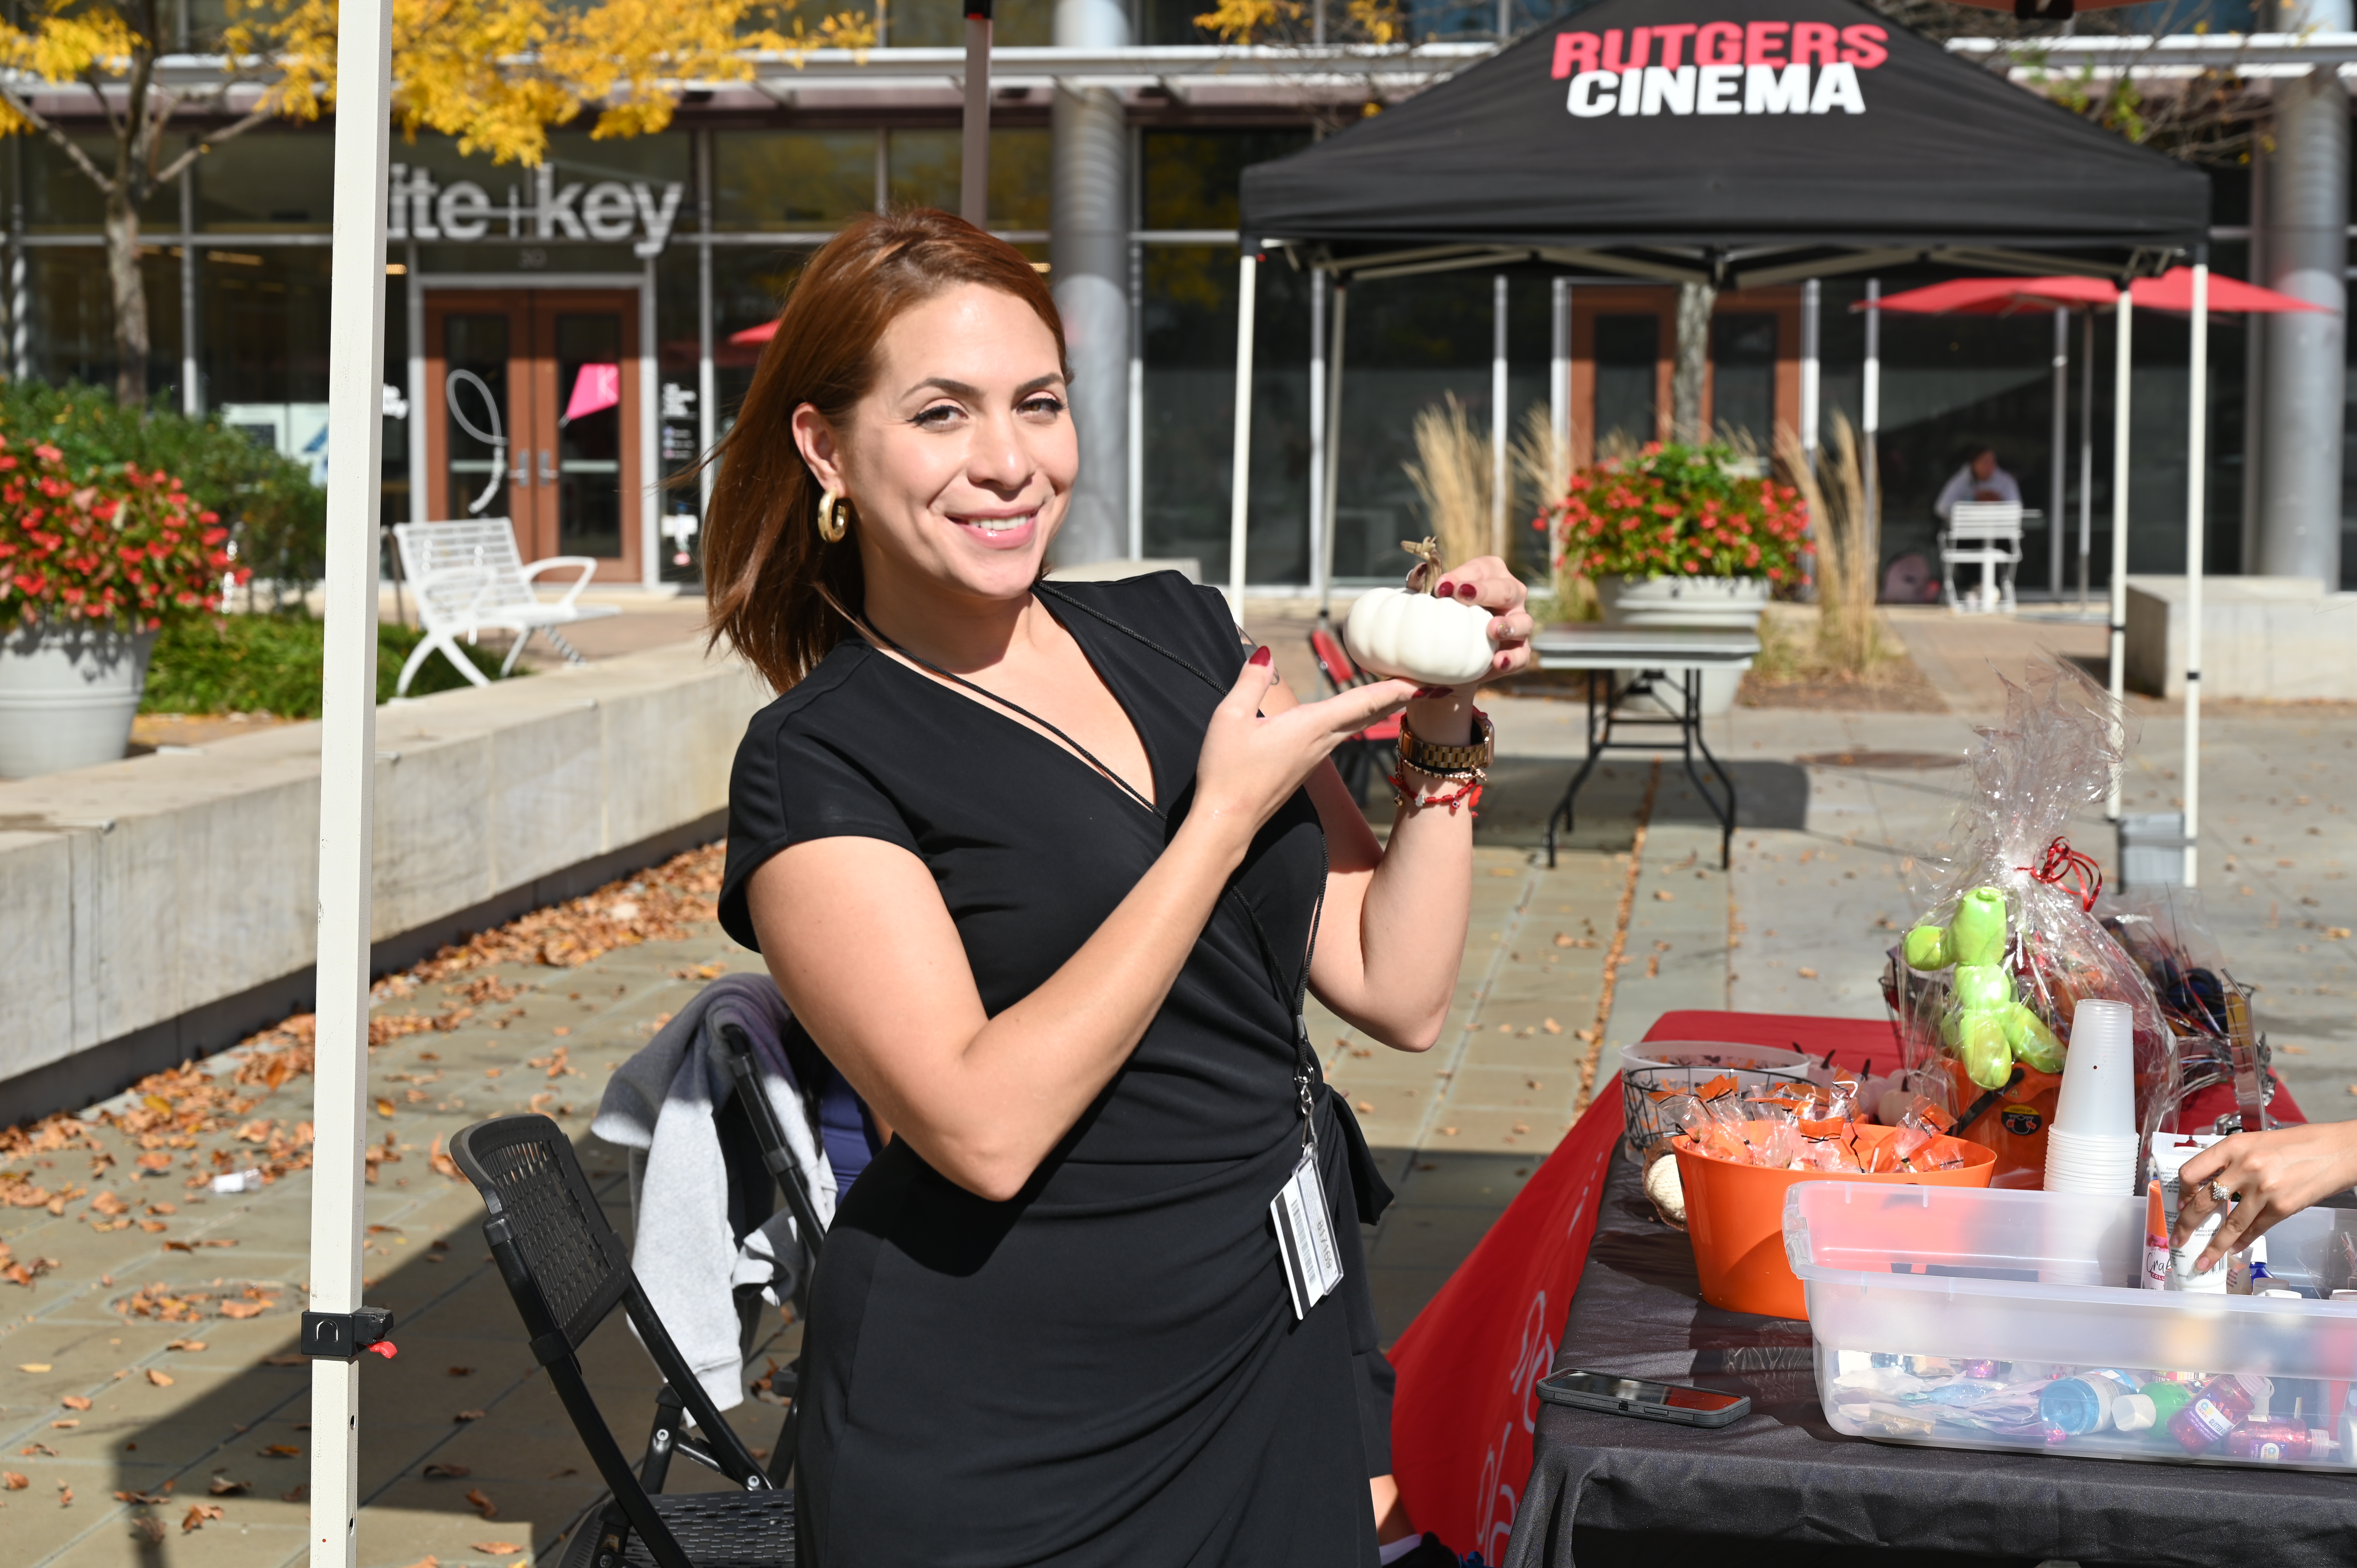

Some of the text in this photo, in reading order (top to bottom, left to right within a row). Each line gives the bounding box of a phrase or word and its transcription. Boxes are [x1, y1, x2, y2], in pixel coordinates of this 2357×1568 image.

[1551, 21, 1889, 80] RUTGERS
[1567, 61, 1866, 118] CINEMA
[387, 162, 682, 257] ite+key
[2197, 1406, 2209, 1419] CREATE!
[2209, 1419, 2222, 1432] GLITTER
